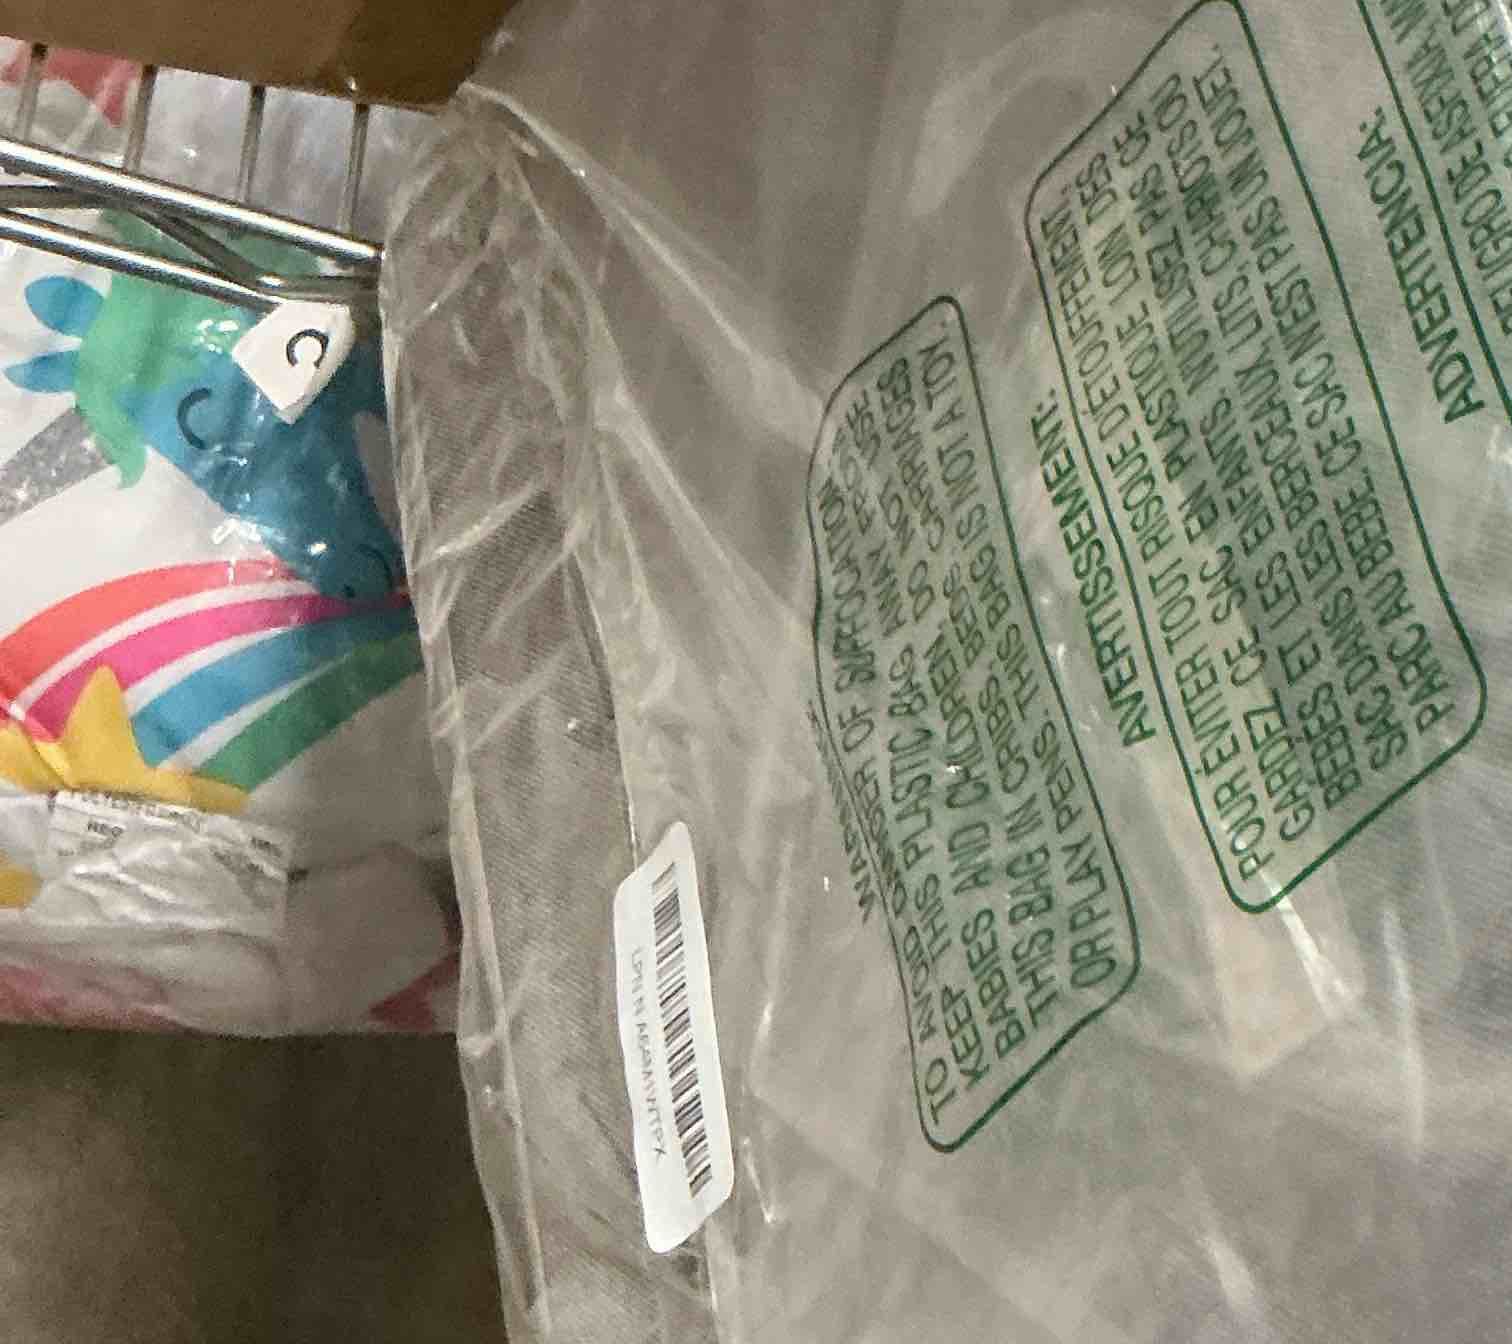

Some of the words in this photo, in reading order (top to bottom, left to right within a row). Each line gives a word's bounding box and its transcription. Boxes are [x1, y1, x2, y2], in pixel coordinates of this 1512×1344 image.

[1112, 111, 1151, 168] CE
[1150, 72, 1188, 133] OU
[1074, 152, 1118, 226] DES
[1128, 162, 1169, 236] PAS
[1166, 119, 1238, 278] CHARIOTS
[1227, 147, 1269, 203] UN
[1445, 140, 1492, 204] DE
[1095, 222, 1141, 307] LOIN
[1242, 195, 1294, 275] PAS
[1360, 107, 1485, 423] ADVERTENCIA:
[932, 398, 965, 434] A
[1115, 301, 1196, 482] PLASTIQUE
[1293, 352, 1348, 430] SAC
[936, 432, 979, 513] NOT
[1314, 416, 1363, 478] CE
[955, 503, 989, 551] IS
[1106, 430, 1174, 563] RISQUE
[1178, 480, 1219, 545] EN
[907, 559, 936, 624] DO
[969, 542, 1011, 630] BAG
[1031, 390, 1155, 747] AVERTISSEMENT:
[1198, 544, 1248, 625] SAC
[1254, 550, 1302, 631] LES
[1294, 518, 1344, 598] LES
[1370, 568, 1415, 628] AU
[1147, 557, 1201, 656] TOUT
[1319, 586, 1380, 696] DANS
[889, 643, 928, 722] BAG
[996, 623, 1040, 722] THIS
[1222, 623, 1268, 688] CE
[1277, 628, 1321, 687] ET
[1386, 623, 1456, 734] PARC
[837, 695, 875, 754] OF
[1175, 644, 1241, 777] ÉVITER
[1354, 684, 1408, 771] SAC
[887, 705, 933, 870] PLASTIC
[1242, 687, 1315, 843] GARDEZ
[947, 820, 993, 896] AND
[1004, 793, 1043, 842] IN
[1213, 767, 1275, 882] POUR
[914, 872, 952, 965] THIS
[1004, 843, 1054, 926] BAG
[1061, 833, 1110, 933] PLAY
[902, 924, 937, 1044] AVOID
[960, 908, 1026, 1059] BABIES
[1011, 927, 1059, 1029] THIS
[1069, 927, 1117, 991] OR
[941, 985, 990, 1090] KEEP
[924, 1057, 957, 1126] TO
